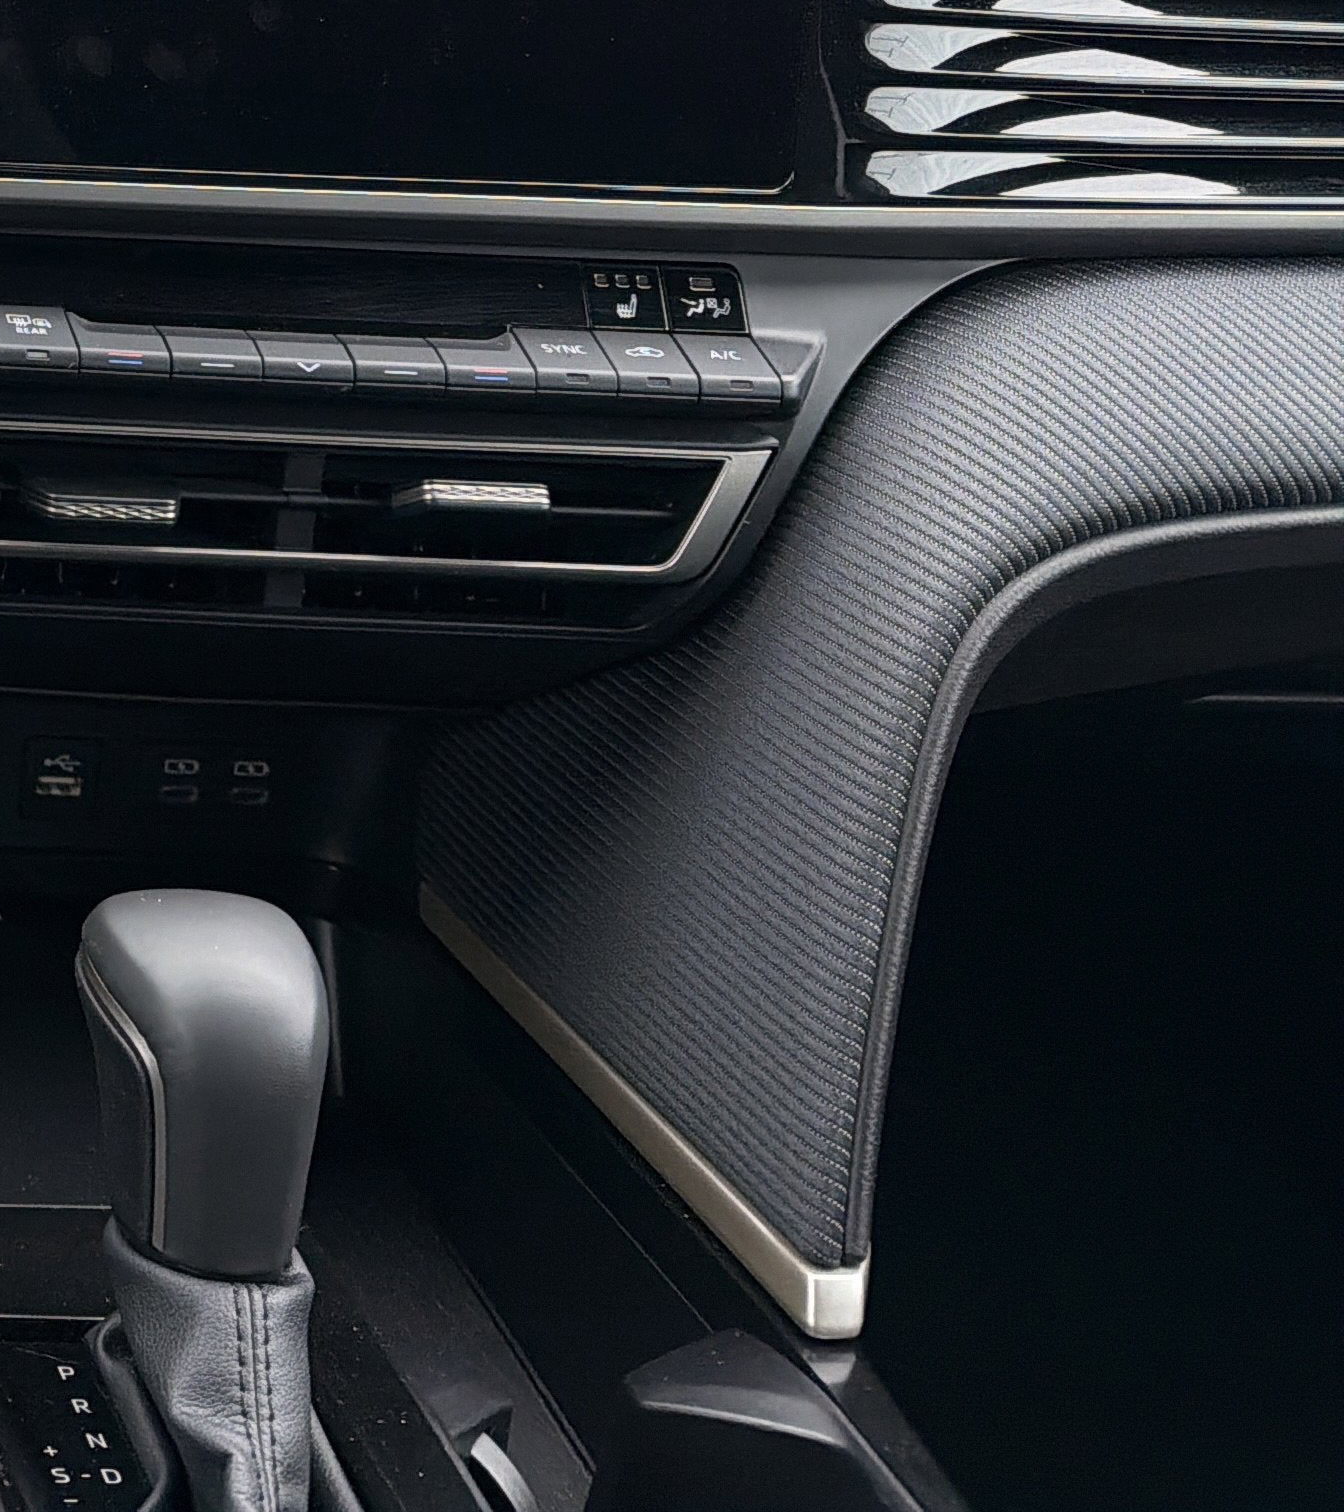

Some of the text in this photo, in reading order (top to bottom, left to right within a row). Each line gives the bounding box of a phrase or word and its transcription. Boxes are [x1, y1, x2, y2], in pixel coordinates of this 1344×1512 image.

[15, 326, 49, 336] REAR
[540, 342, 588, 355] SYNC
[710, 349, 742, 361] A/C
[56, 1366, 75, 1380] P
[70, 1398, 93, 1414] R
[85, 1433, 109, 1449] N
[50, 1468, 123, 1484] S D
